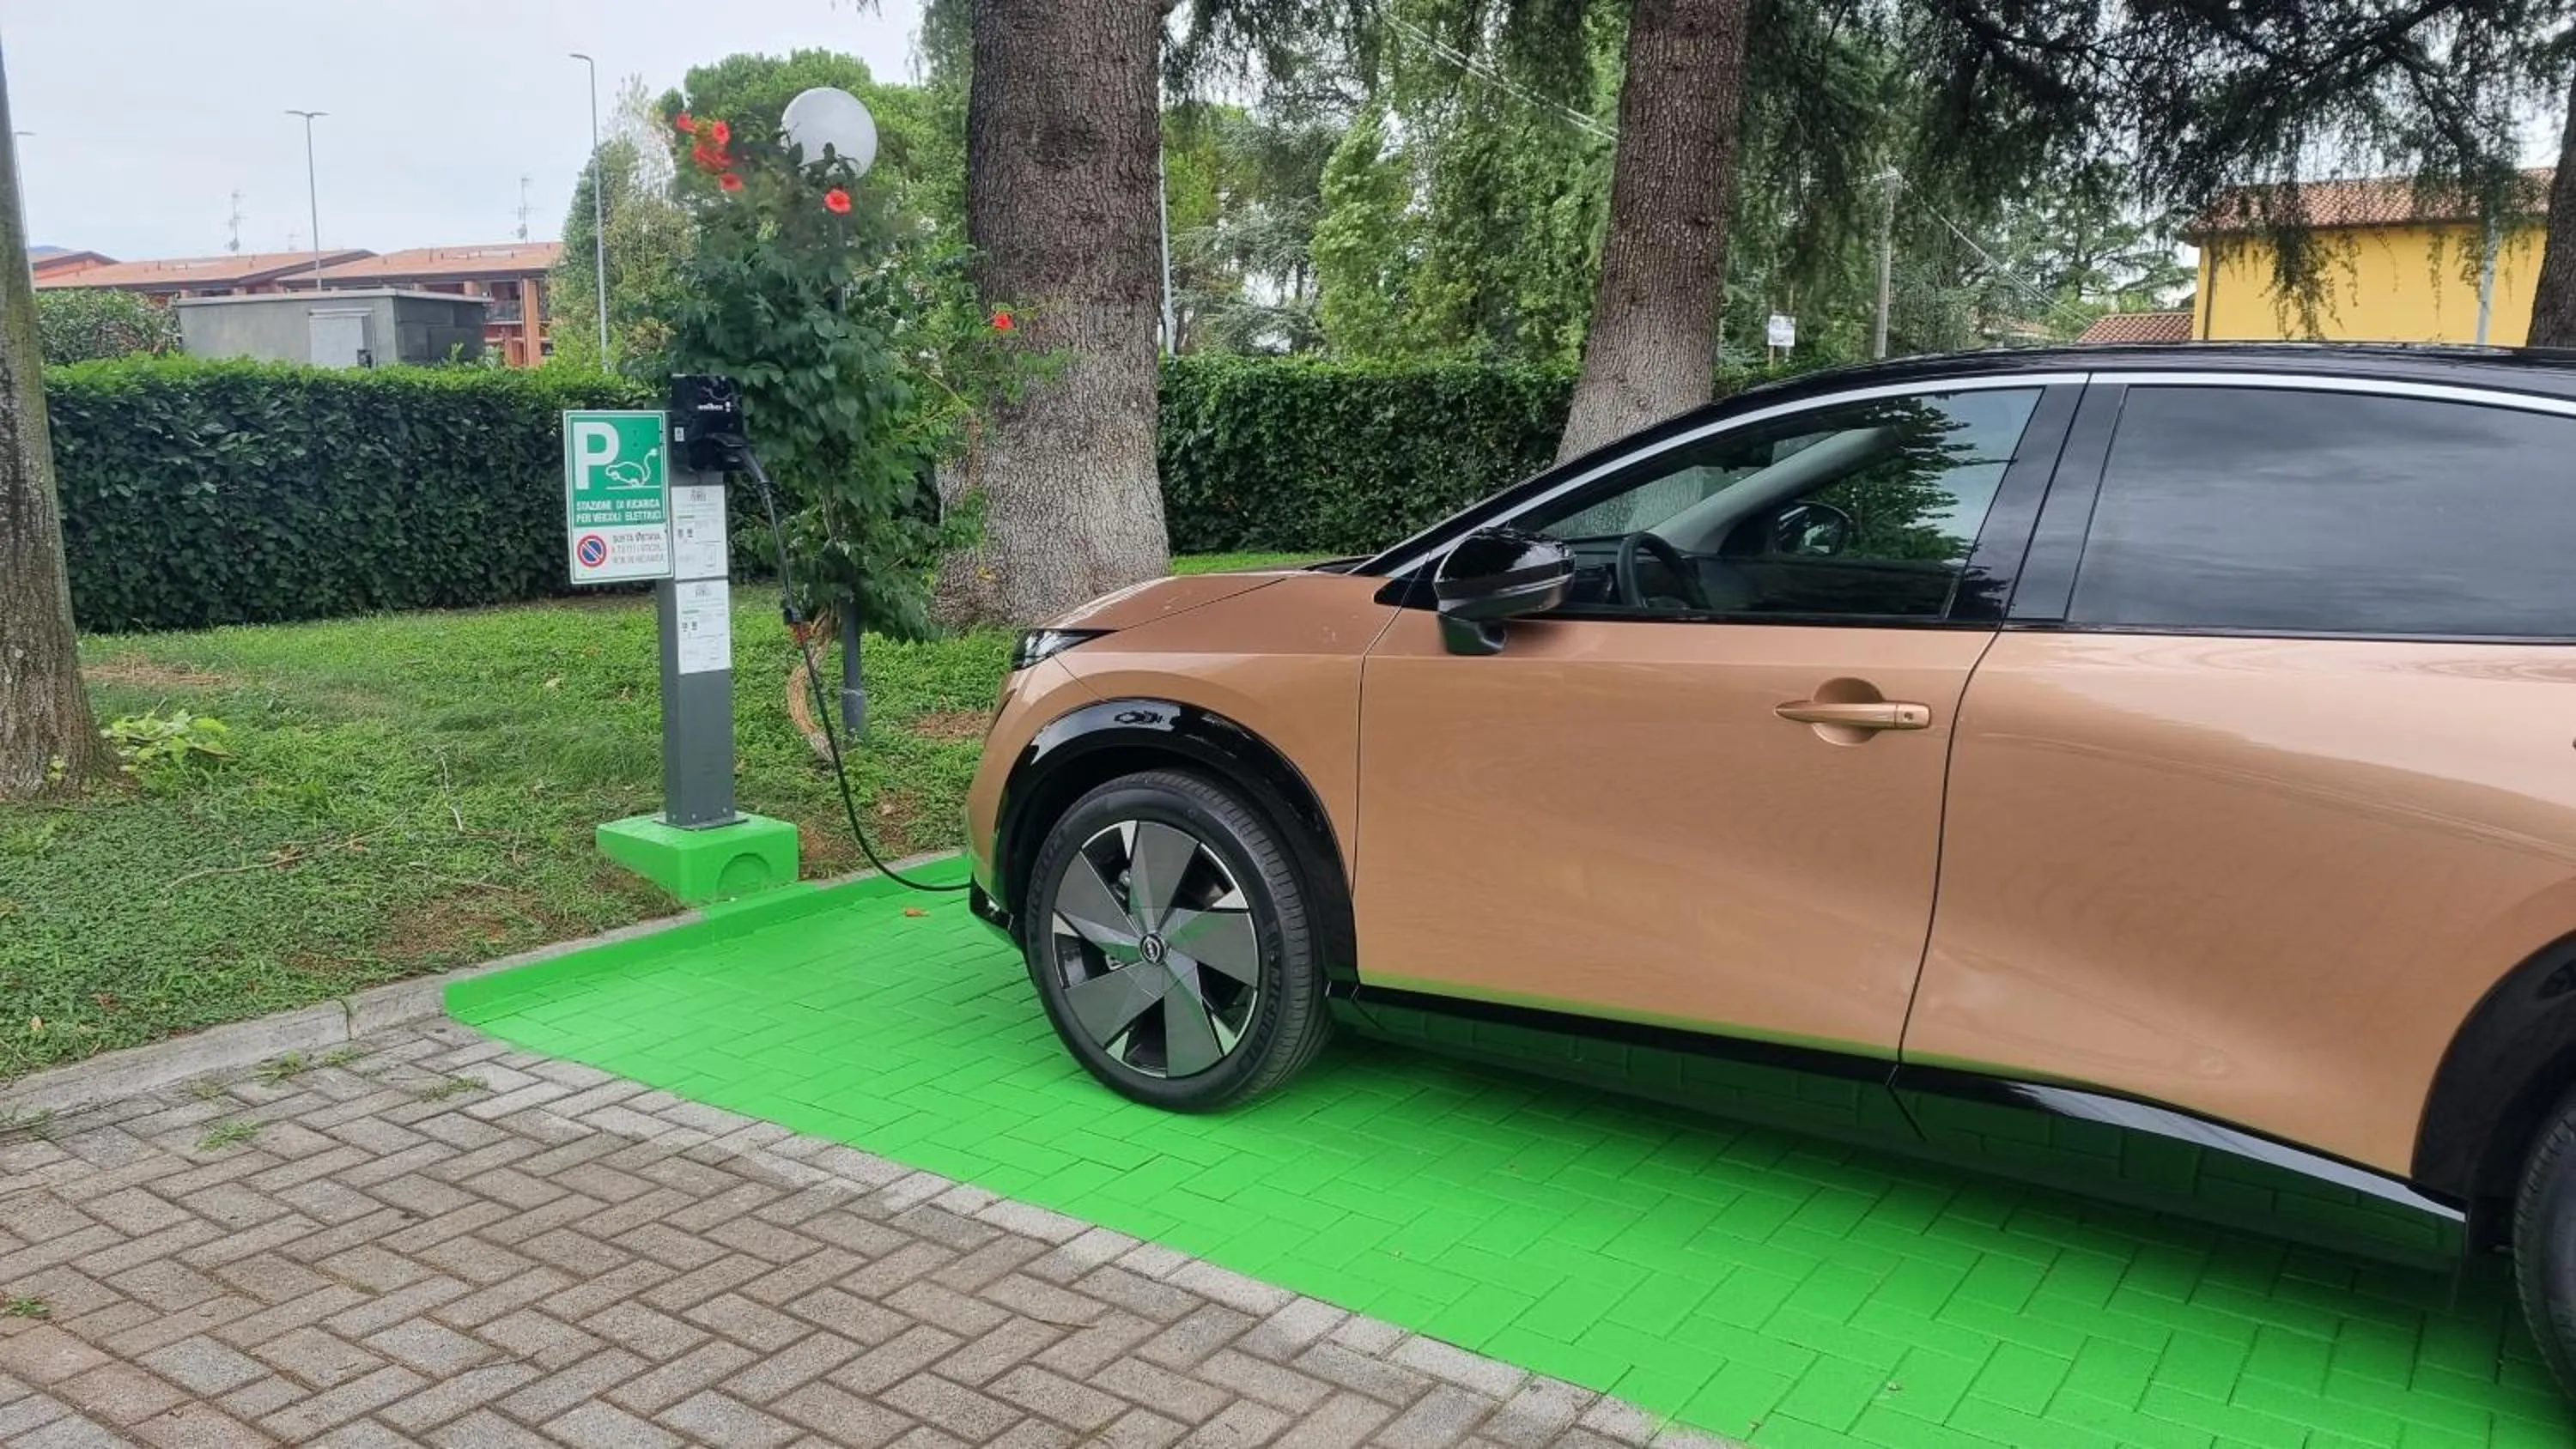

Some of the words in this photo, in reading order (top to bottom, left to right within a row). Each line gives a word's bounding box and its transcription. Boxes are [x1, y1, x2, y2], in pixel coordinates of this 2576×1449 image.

[573, 421, 620, 490] P
[576, 500, 611, 510] STAZIONE
[616, 500, 624, 509] DI
[626, 499, 660, 509] RICARICA
[576, 512, 592, 523] PER
[592, 512, 621, 522] VEICOLI
[625, 511, 661, 520] ELETTRICI
